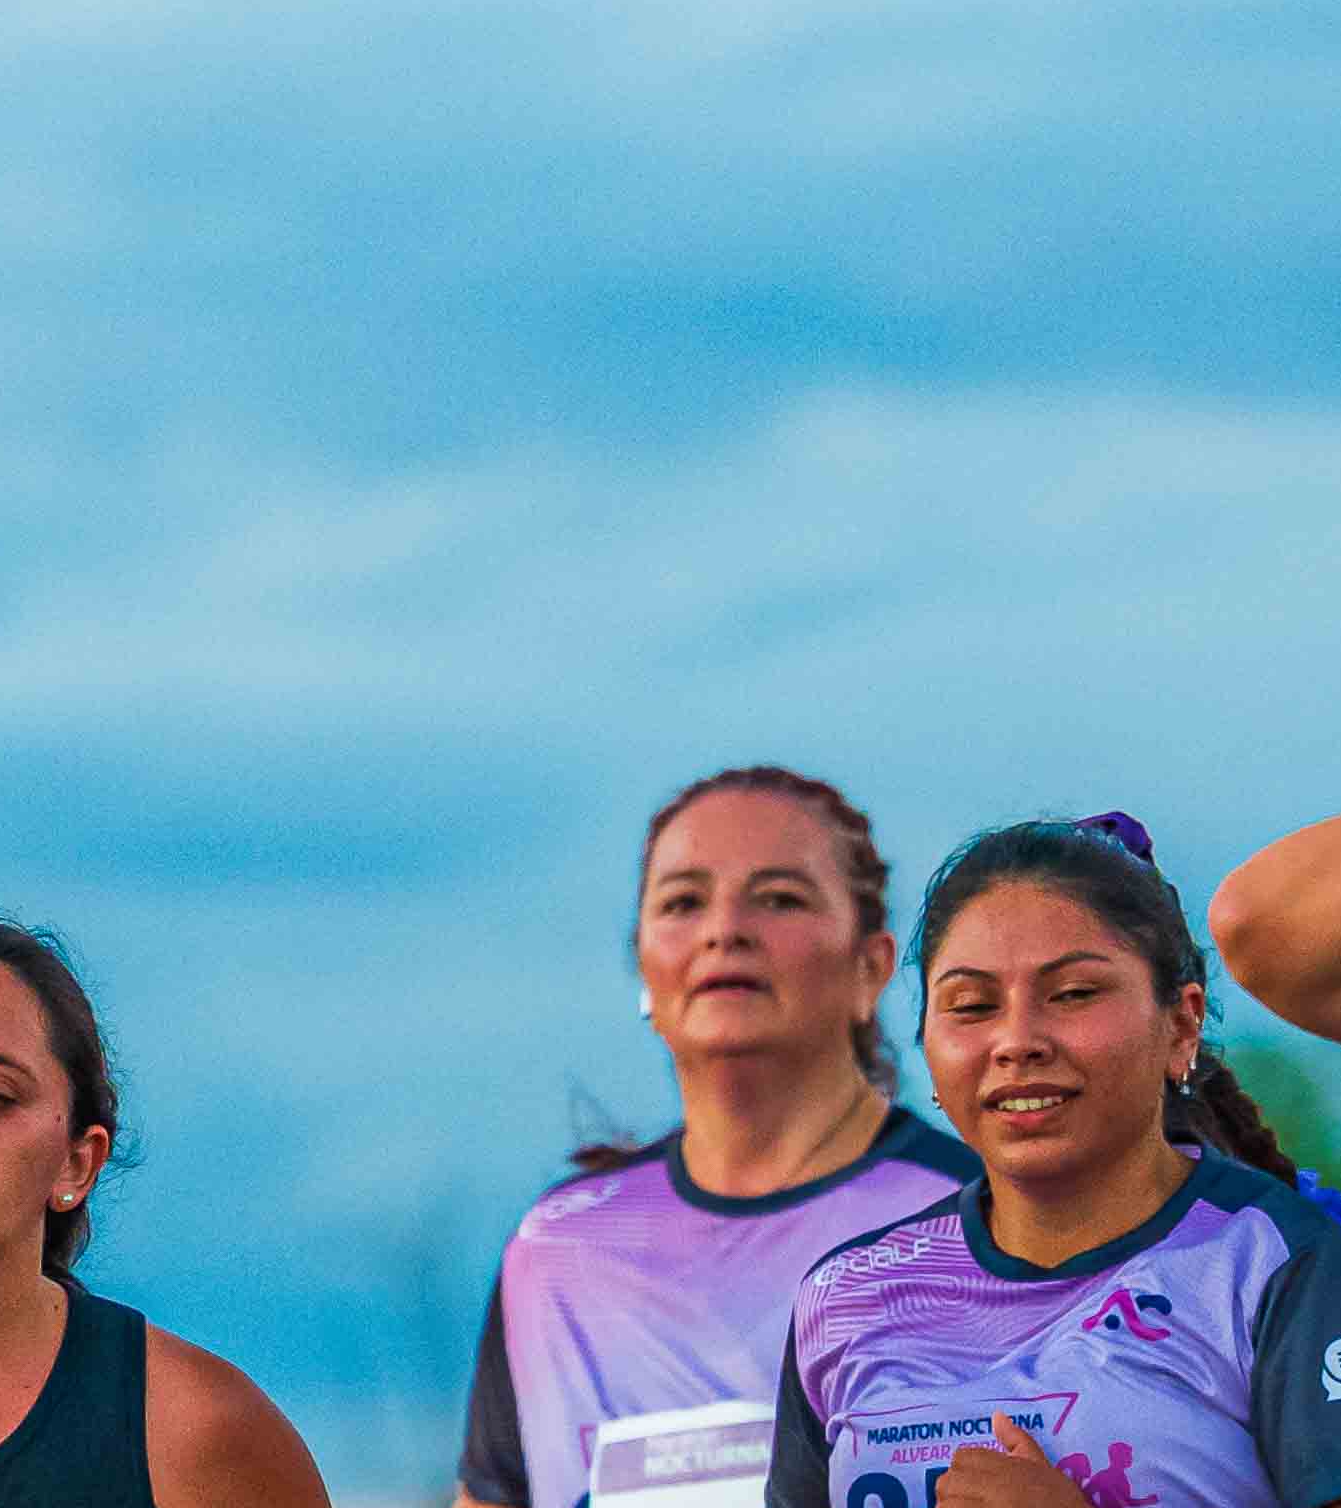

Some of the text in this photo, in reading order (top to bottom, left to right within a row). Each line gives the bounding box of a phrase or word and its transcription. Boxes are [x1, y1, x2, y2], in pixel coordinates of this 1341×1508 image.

[867, 1413, 1045, 1445] MARATON NOCTNA
[890, 1444, 951, 1464] ALVEAR
